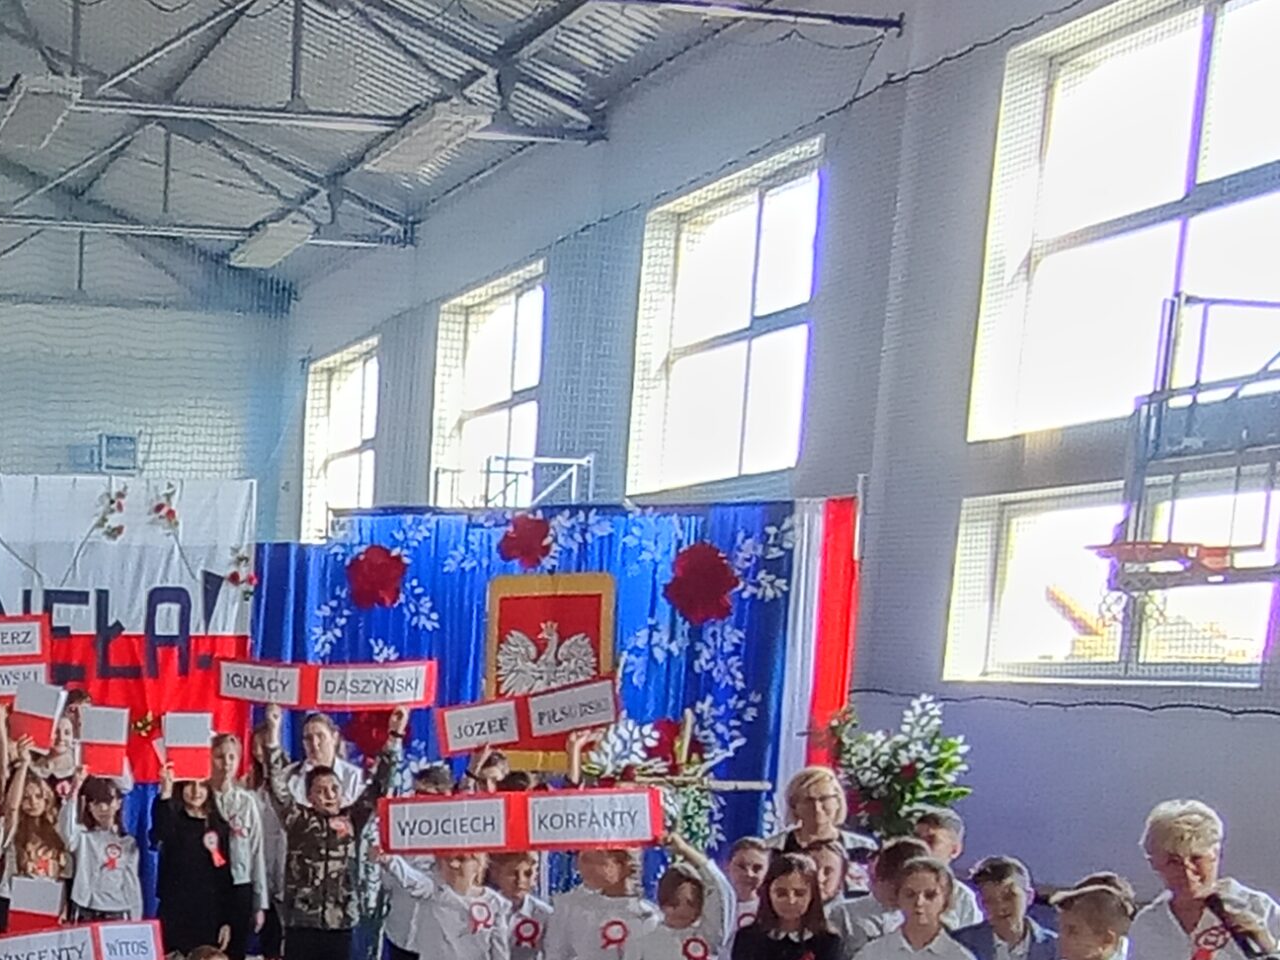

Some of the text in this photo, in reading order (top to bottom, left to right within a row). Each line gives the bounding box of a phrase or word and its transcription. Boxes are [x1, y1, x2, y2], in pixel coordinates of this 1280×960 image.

[226, 673, 420, 695] IGNACY DASZYŃSKI
[396, 808, 638, 838] WOJCIECH KORFANTY
[106, 939, 149, 957] WITOS
